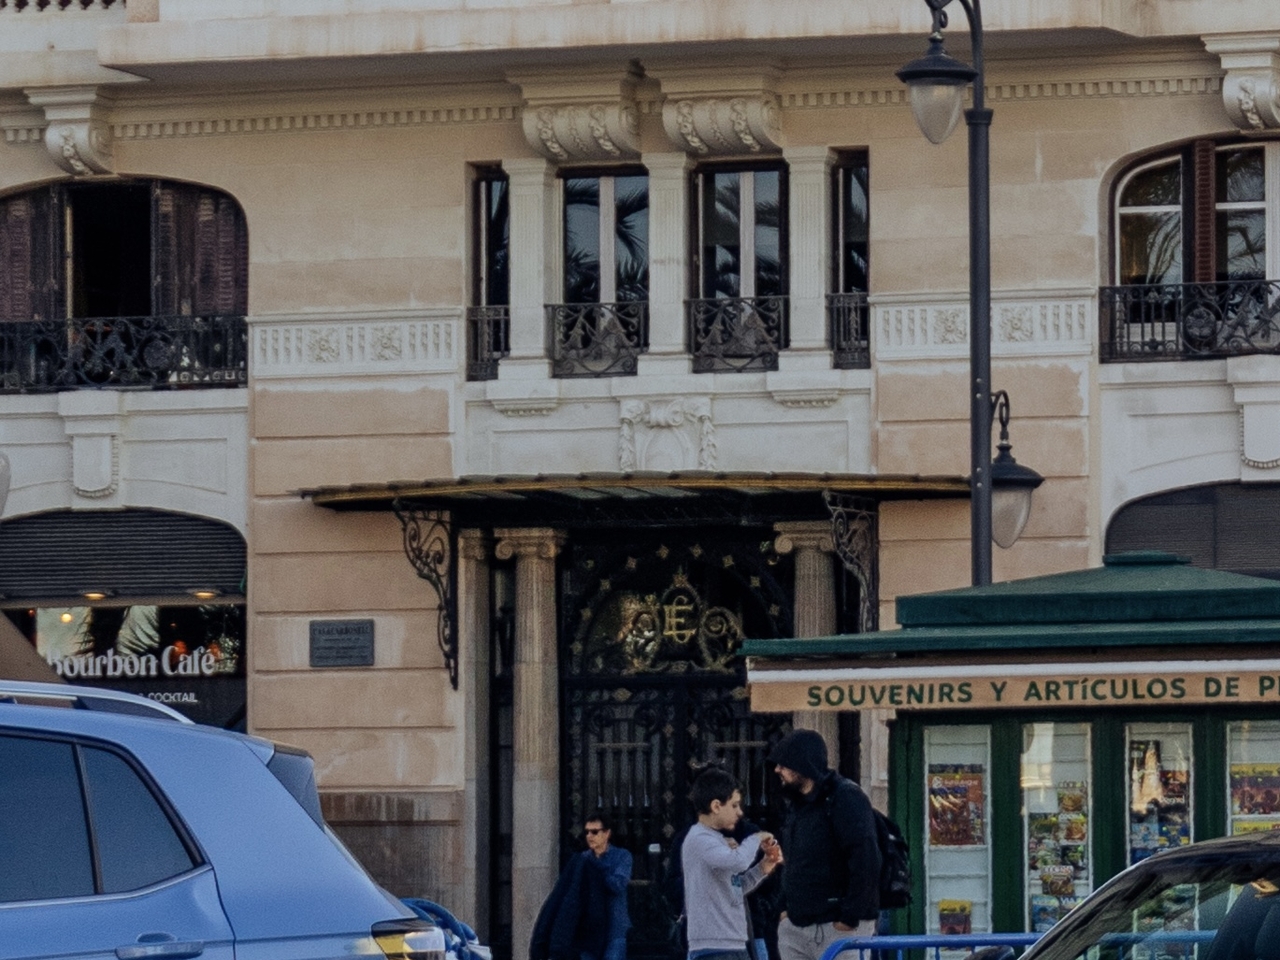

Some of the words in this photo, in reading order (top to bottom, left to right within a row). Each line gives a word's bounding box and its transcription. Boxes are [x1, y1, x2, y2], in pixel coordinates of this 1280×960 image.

[161, 645, 215, 676] Café
[148, 691, 198, 703] COCKTAIL
[807, 682, 973, 707] SOUVENIRS
[990, 681, 1008, 702] Y
[1204, 677, 1240, 697] DE
